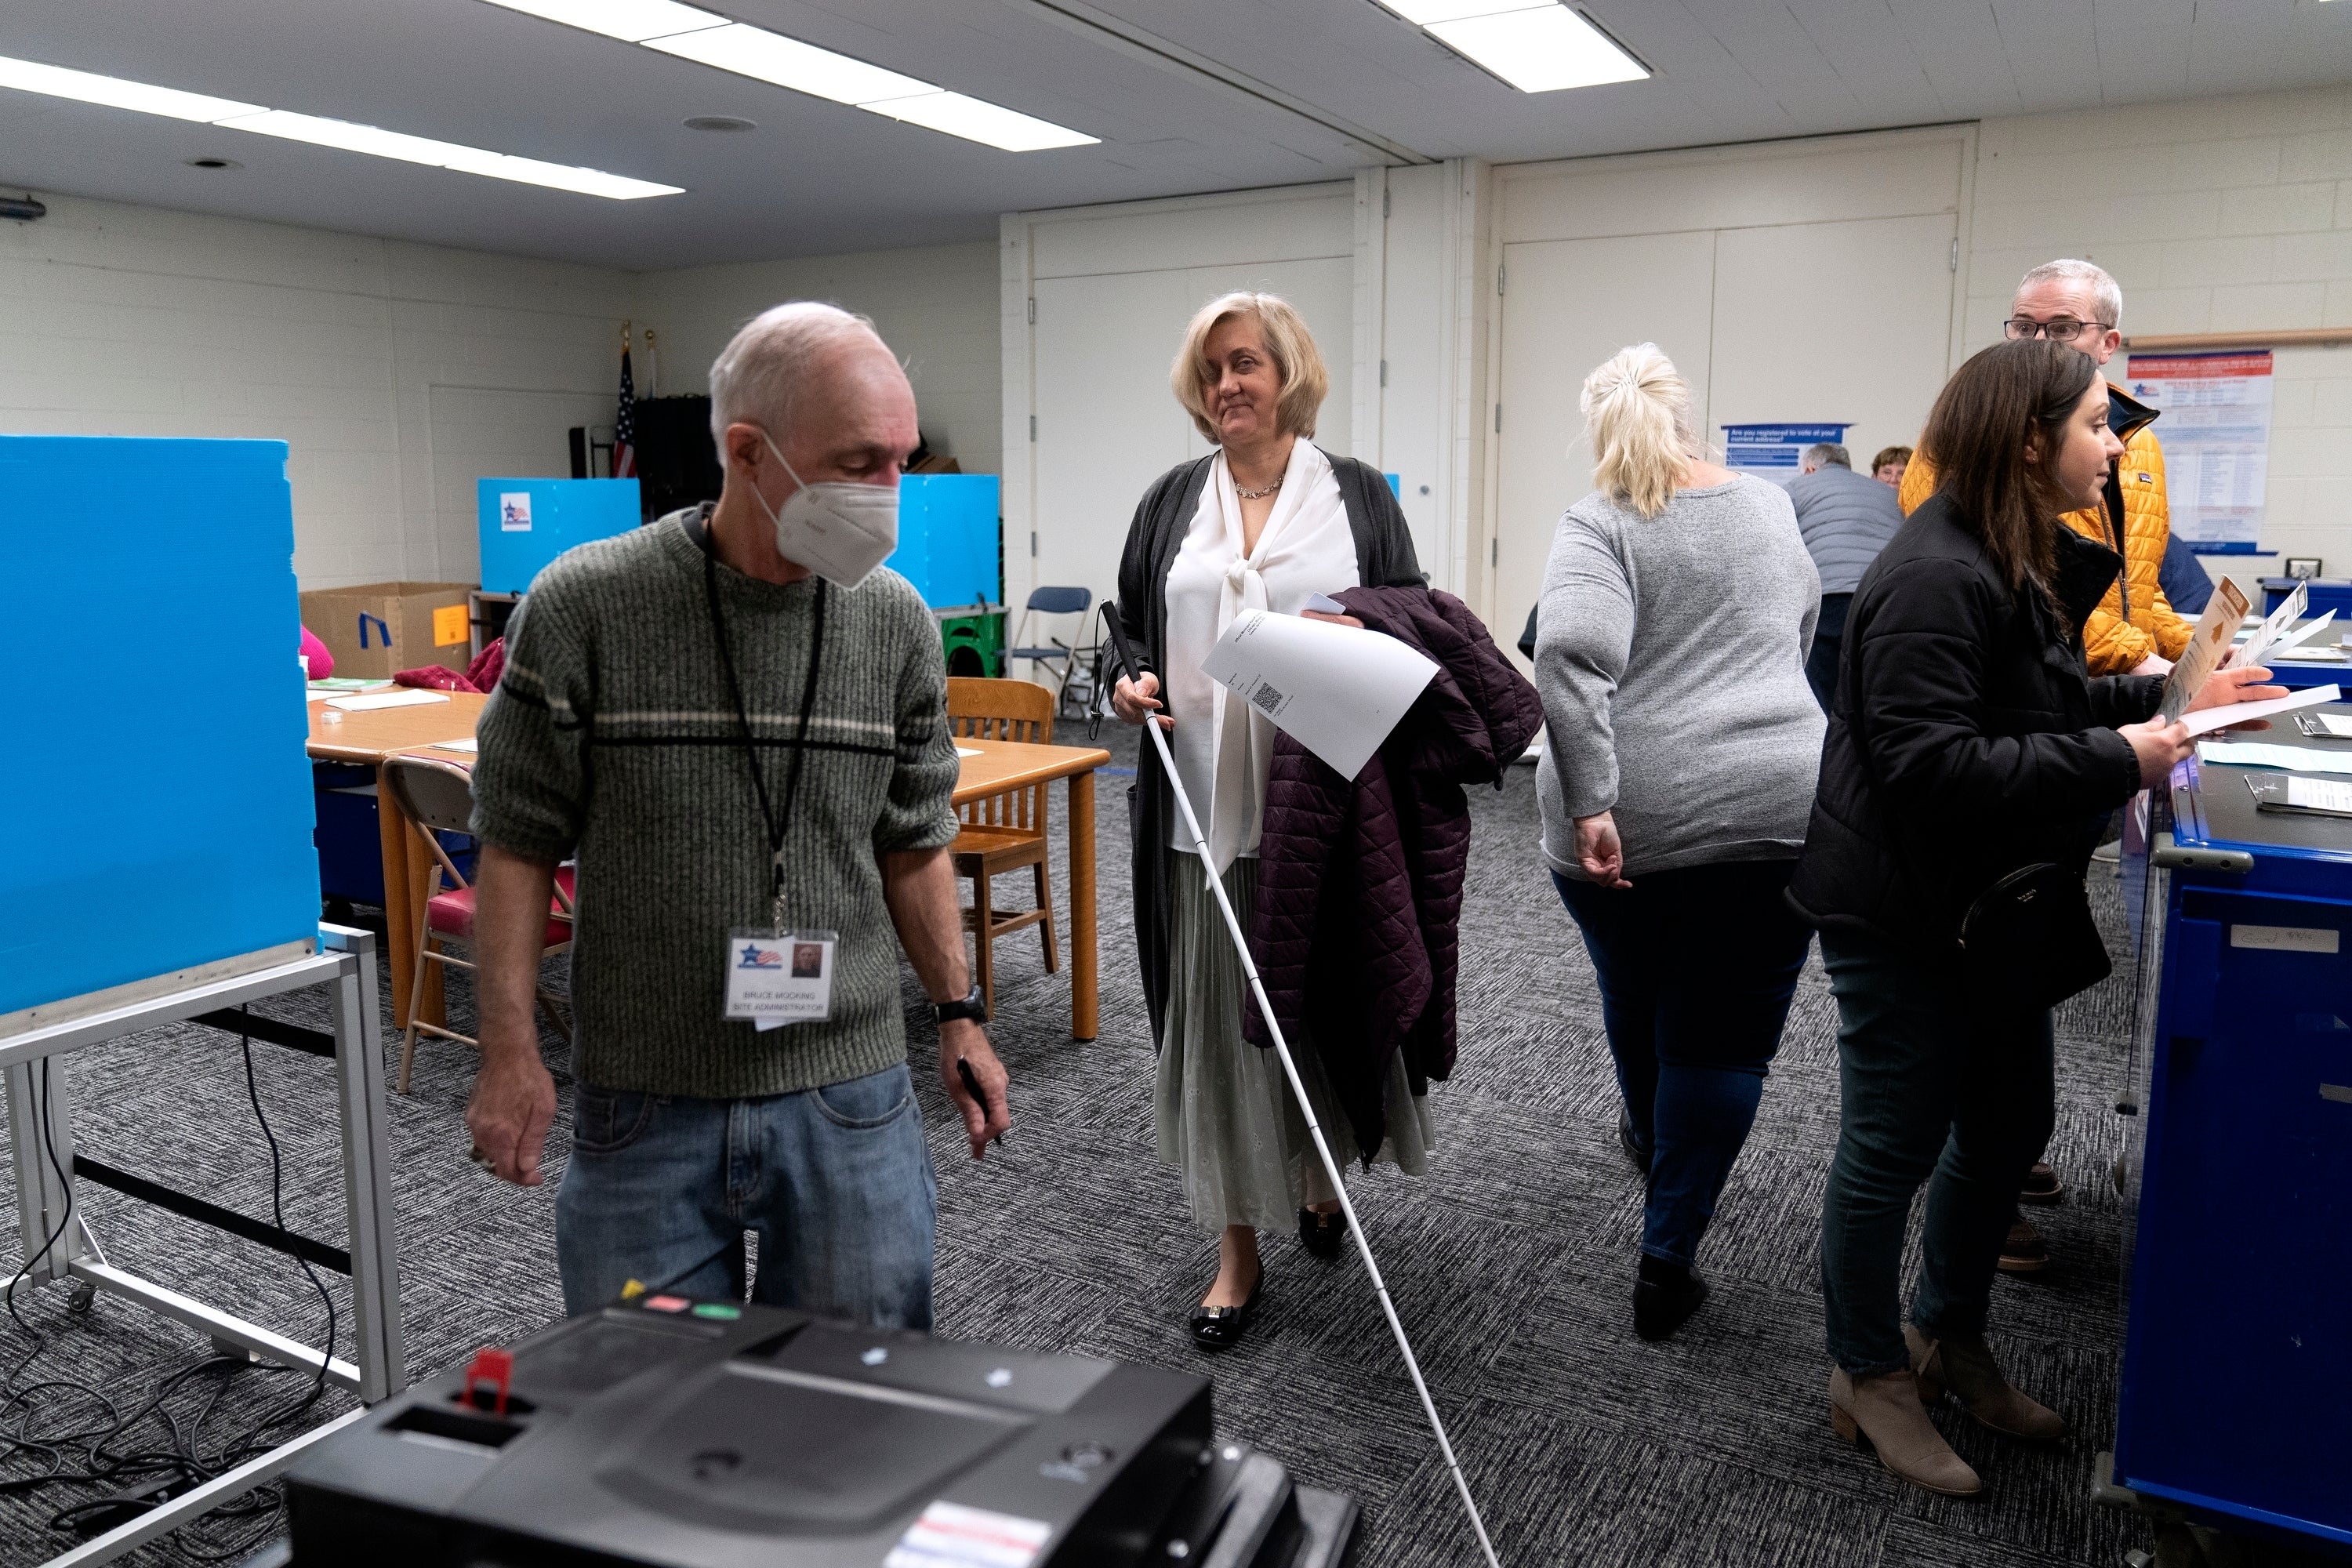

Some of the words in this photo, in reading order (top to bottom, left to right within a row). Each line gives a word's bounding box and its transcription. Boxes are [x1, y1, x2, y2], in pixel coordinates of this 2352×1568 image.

[1757, 429, 1788, 437] registered
[743, 991, 773, 1000] BRUCE
[754, 1003, 824, 1011] ADMINISTRATOR
